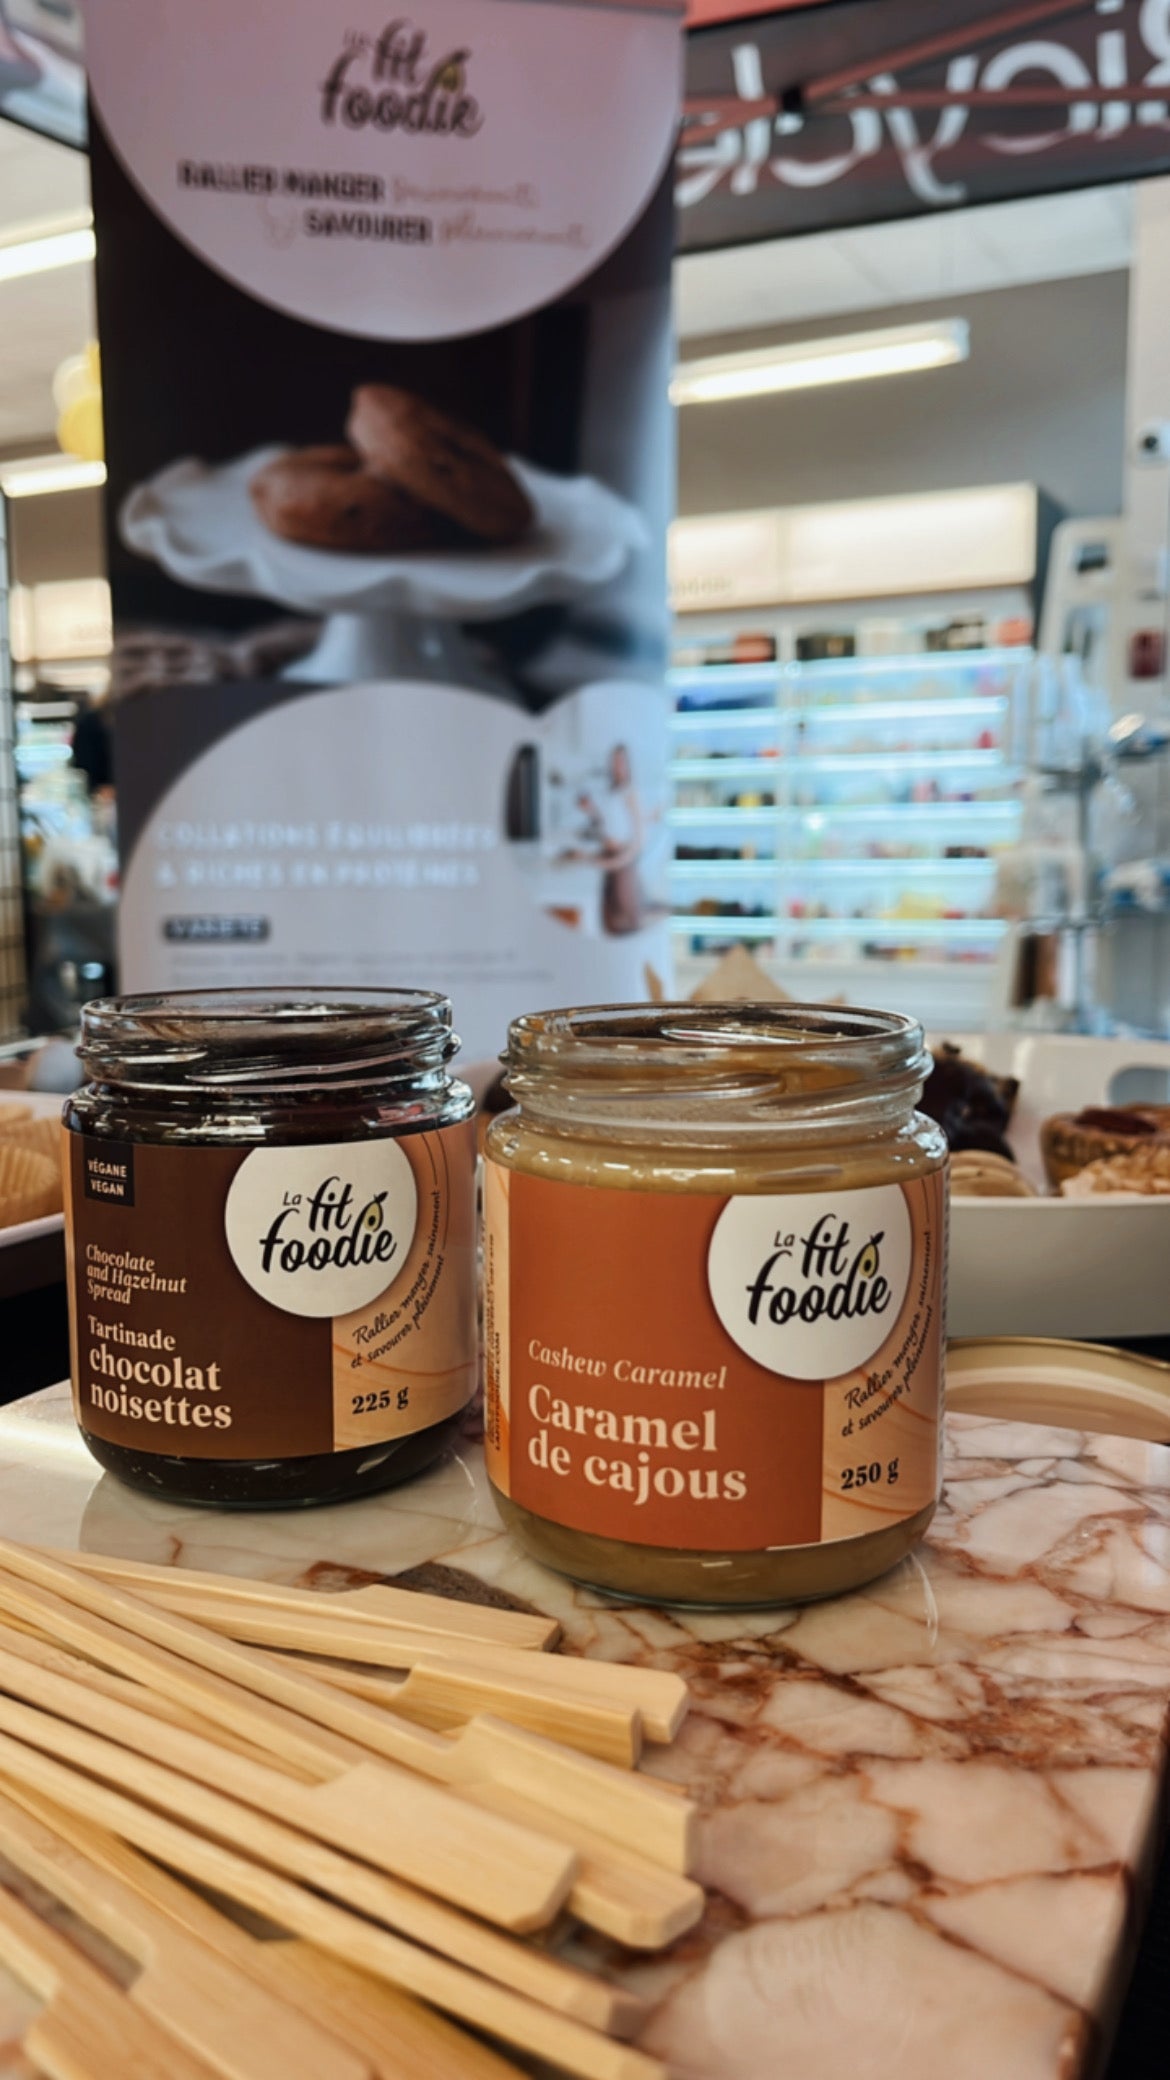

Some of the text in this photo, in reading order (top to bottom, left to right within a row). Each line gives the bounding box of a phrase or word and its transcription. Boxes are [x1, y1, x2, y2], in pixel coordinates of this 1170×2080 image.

[372, 16, 431, 88] fit
[319, 45, 486, 138] foodie
[304, 210, 433, 245] SAVOURER
[87, 1158, 127, 1178] VÉGANE
[90, 1179, 125, 1196] VEGAN
[283, 1176, 353, 1232] La fit
[86, 1244, 155, 1272] Chocolate
[259, 1199, 397, 1274] foodie
[774, 1213, 850, 1278] La fit
[87, 1264, 187, 1293] and Hazelnut
[87, 1278, 131, 1304] Spread
[746, 1238, 892, 1325] foodie
[352, 1311, 402, 1345] Rallier
[400, 1260, 430, 1309] manger
[88, 1314, 176, 1351] Tartinade
[351, 1352, 363, 1369] et
[367, 1323, 413, 1363] savourer
[89, 1343, 222, 1391] chocolat
[528, 1339, 727, 1389] Cashew Caramel
[91, 1383, 232, 1429] noisettes
[352, 1386, 409, 1414] 225 g
[844, 1373, 893, 1409] Rallier
[528, 1384, 717, 1451] Caramel
[841, 1418, 853, 1437] et
[528, 1429, 747, 1505] de cajous
[841, 1458, 899, 1490] 250 g
